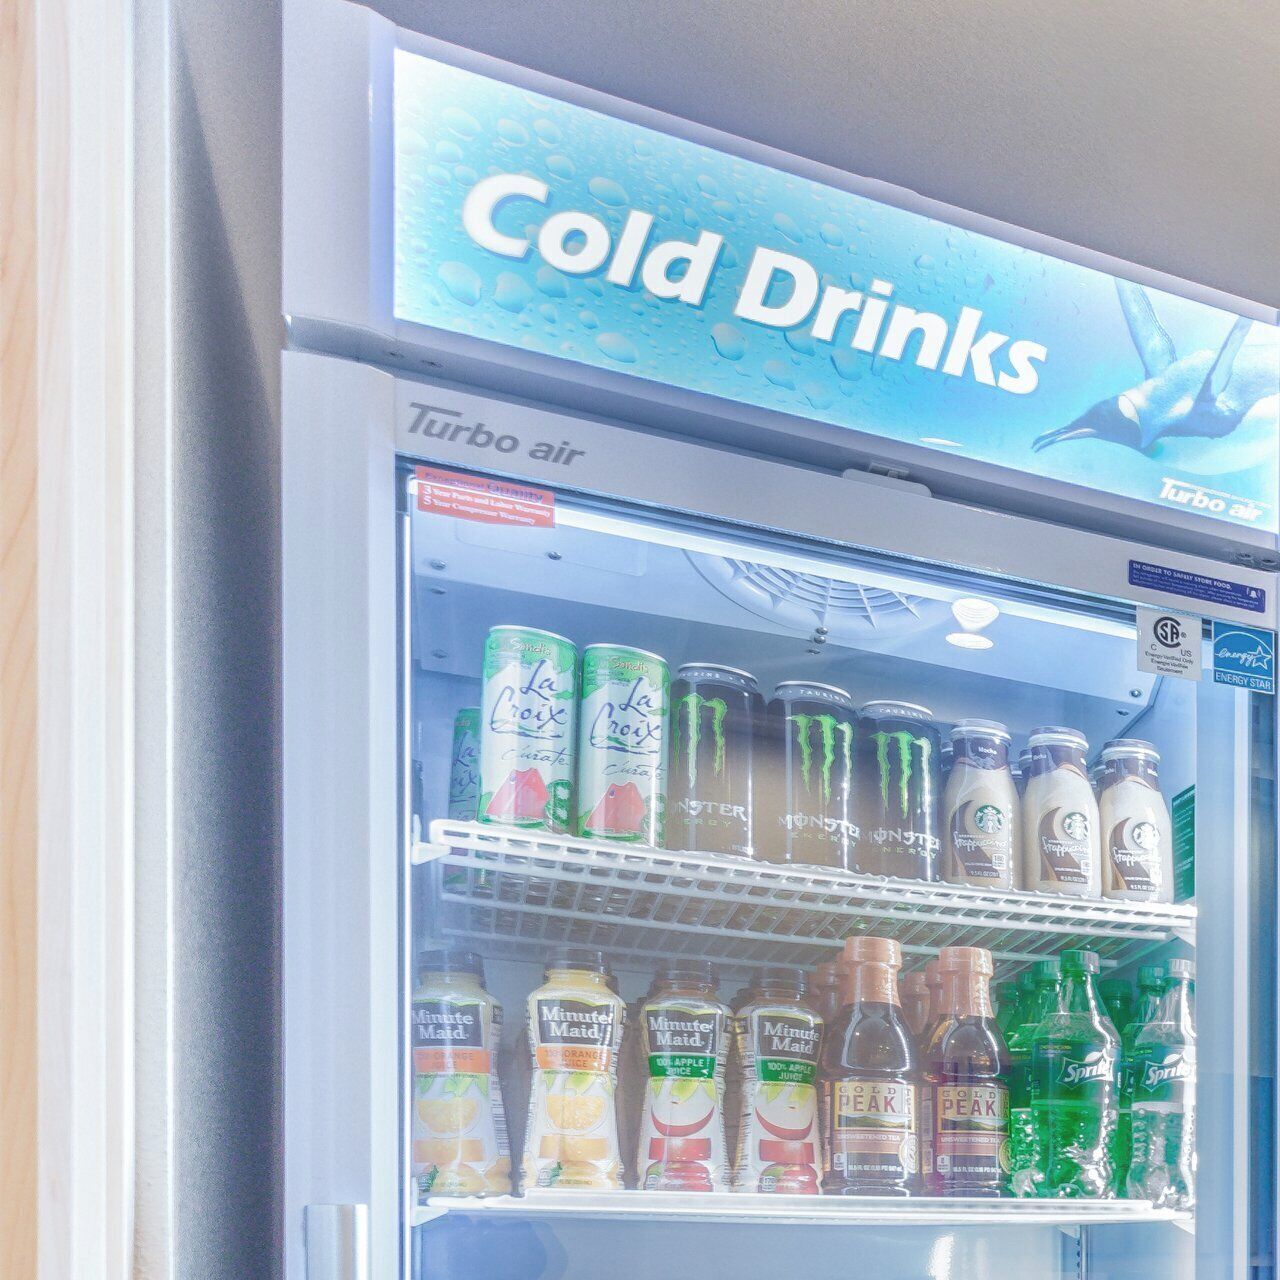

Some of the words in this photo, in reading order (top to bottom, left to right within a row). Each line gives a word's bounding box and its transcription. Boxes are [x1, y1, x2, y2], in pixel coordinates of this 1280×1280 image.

[461, 172, 725, 309] Cold
[732, 243, 1048, 396] Drinks
[408, 402, 520, 453] Turbo
[528, 441, 587, 466] air
[1159, 477, 1227, 513] Turbo
[1228, 502, 1264, 522] air
[519, 659, 558, 701] La
[1215, 672, 1248, 686] ENERGY
[1249, 678, 1272, 690] STAR
[618, 676, 654, 718] La
[490, 685, 568, 735] Croix
[590, 702, 662, 747] Croix
[413, 1009, 474, 1025] Minute
[542, 1006, 612, 1023] Minute
[418, 1024, 467, 1040] Maid
[549, 1021, 602, 1039] Maid
[649, 1016, 709, 1032] Minute
[764, 1021, 819, 1042] Minute
[656, 1031, 703, 1047] Maid
[771, 1036, 814, 1055] Maid
[666, 1067, 692, 1076] JUICE
[674, 1058, 704, 1068] APPLE
[788, 1063, 813, 1075] APPLE
[779, 1072, 803, 1081] JUICE
[839, 1085, 897, 1095] GOLD
[941, 1090, 997, 1100] GOLD
[838, 1095, 897, 1113] PEAK
[941, 1098, 997, 1117] PEAK
